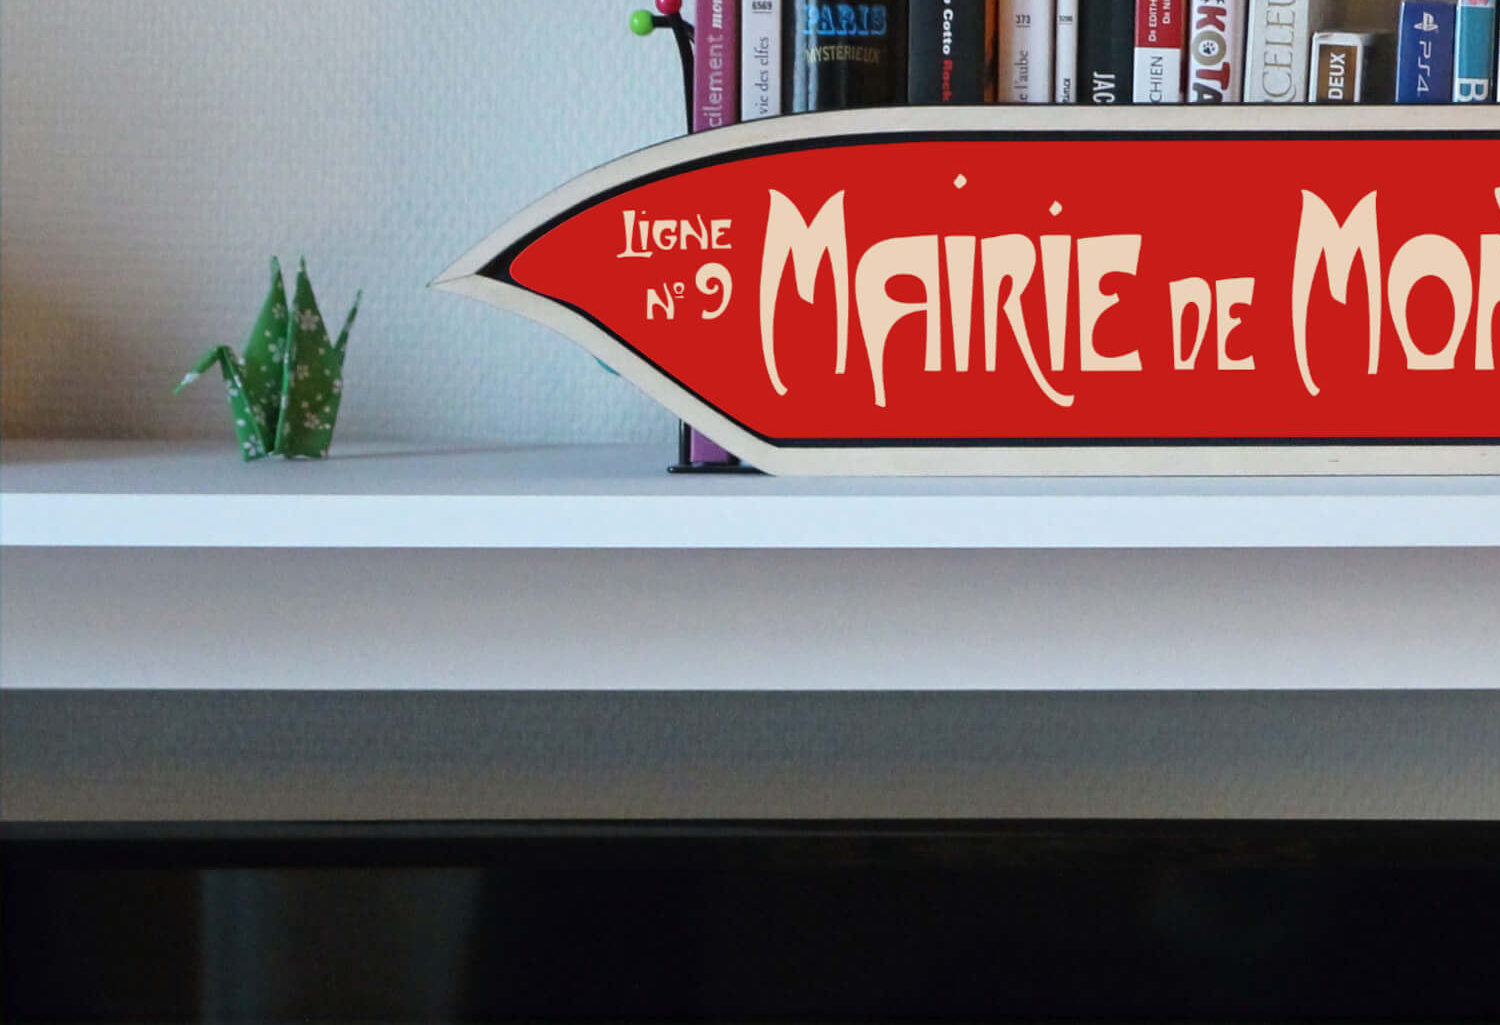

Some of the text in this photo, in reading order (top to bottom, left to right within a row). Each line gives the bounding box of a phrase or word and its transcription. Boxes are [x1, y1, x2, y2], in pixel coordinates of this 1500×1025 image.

[803, 4, 887, 35] PARIS
[942, 9, 954, 55] Cotto
[1149, 0, 1158, 27] EDITH
[755, 36, 770, 115] vie des elfes
[1328, 52, 1346, 100] DEUX
[1416, 40, 1432, 97] PS4
[695, 262, 732, 320] 9
[760, 173, 1142, 407] MAIRIE
[1169, 277, 1255, 370] DE
